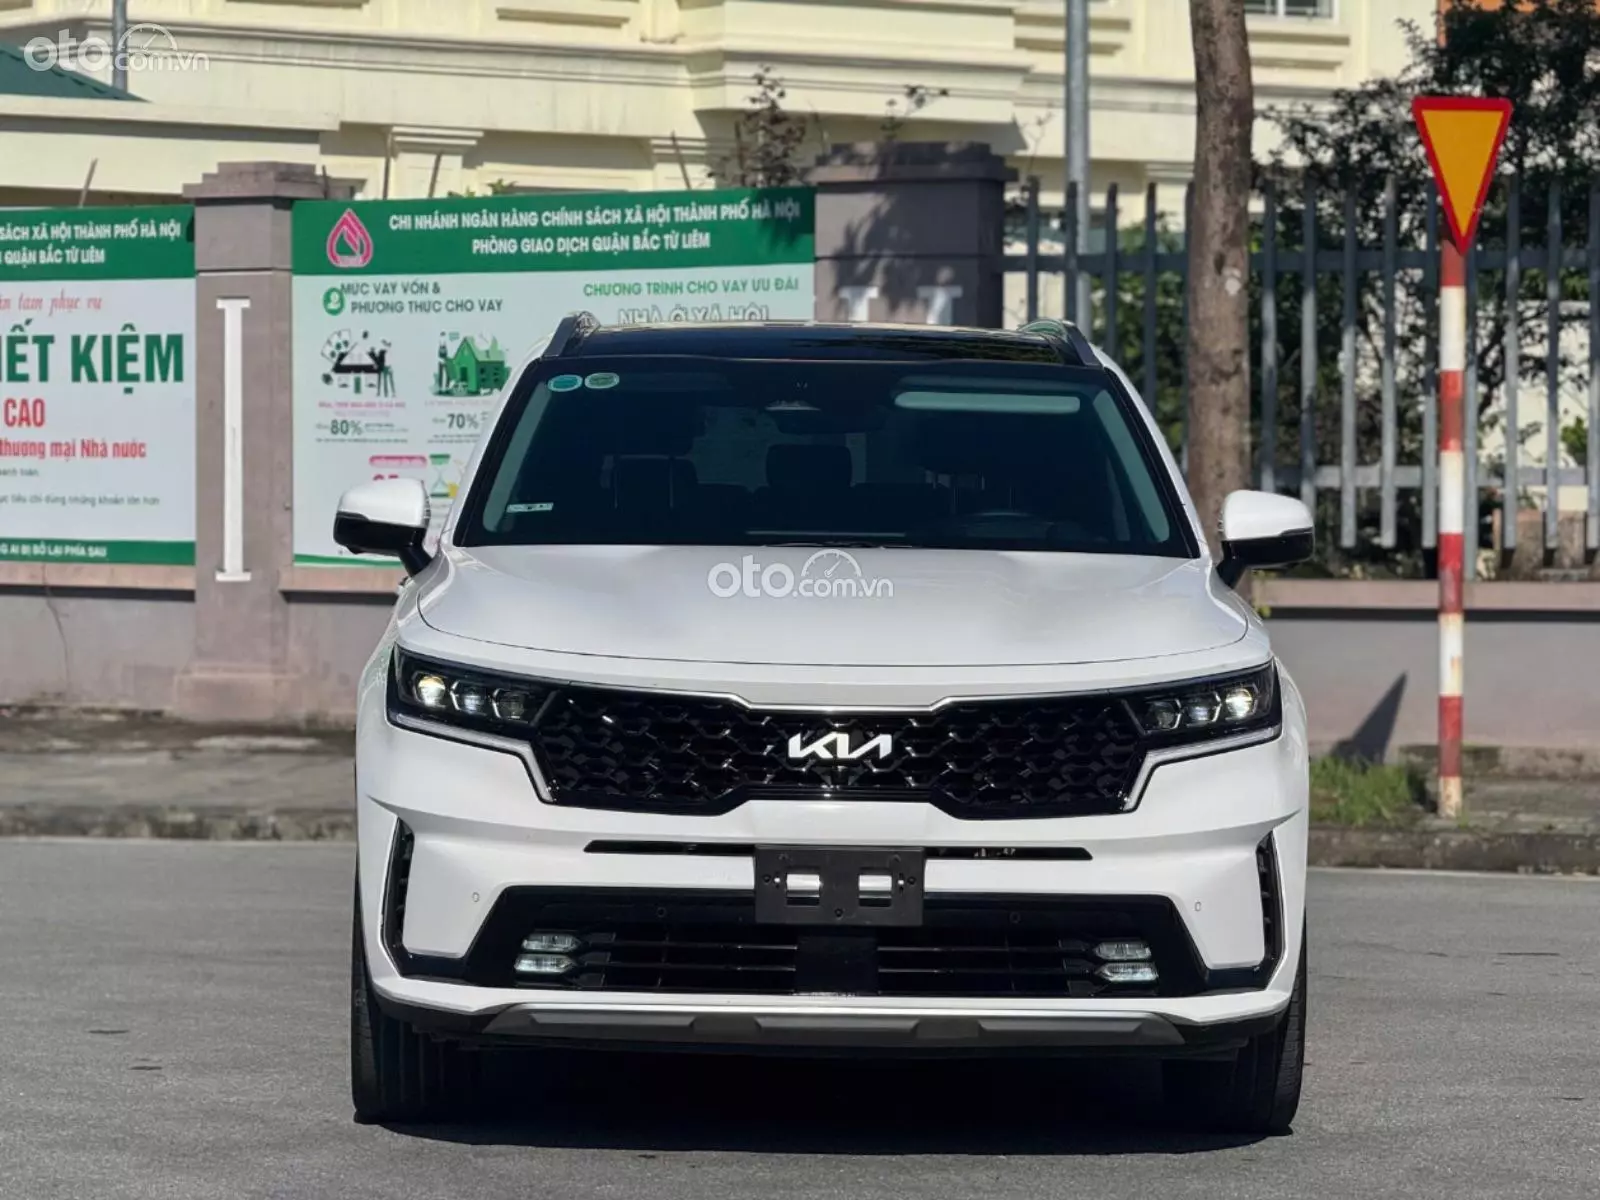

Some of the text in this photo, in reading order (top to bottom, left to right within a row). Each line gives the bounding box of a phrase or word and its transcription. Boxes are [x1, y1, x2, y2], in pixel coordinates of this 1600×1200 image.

[389, 197, 800, 230] CHI NHÁNH NGÂN HÀNG CHÍNH SÁCH XÃ HỘI THÀNH PHỐ HÀ NỘI
[0, 218, 181, 243] SÁCH XÃ HỘI THÀNH PHỐ HÀ NỘI
[472, 227, 710, 257] PHÒNG GIAO DỊCH QUẬN BẮC TỪ LIÊM
[4, 246, 36, 268] QUẬN
[39, 243, 63, 263] BẮC
[65, 245, 80, 263] TỪ
[81, 244, 105, 263] LIÊM
[373, 282, 396, 295] VAY
[400, 278, 426, 295] VỐN
[583, 280, 642, 297] CHƯƠNG
[646, 279, 684, 296] TRÌNH
[686, 280, 718, 294] CHO
[722, 279, 748, 294] VAY
[445, 299, 475, 313] CHO
[479, 298, 503, 312] VAY
[0, 318, 184, 394] ẾT KIỆM
[4, 398, 46, 428] CAO
[446, 412, 479, 429] 70%
[330, 419, 363, 436] 80%
[50, 438, 76, 462] mại
[81, 437, 108, 459] Nhà
[112, 439, 147, 459] nước
[788, 731, 892, 759] KIA
